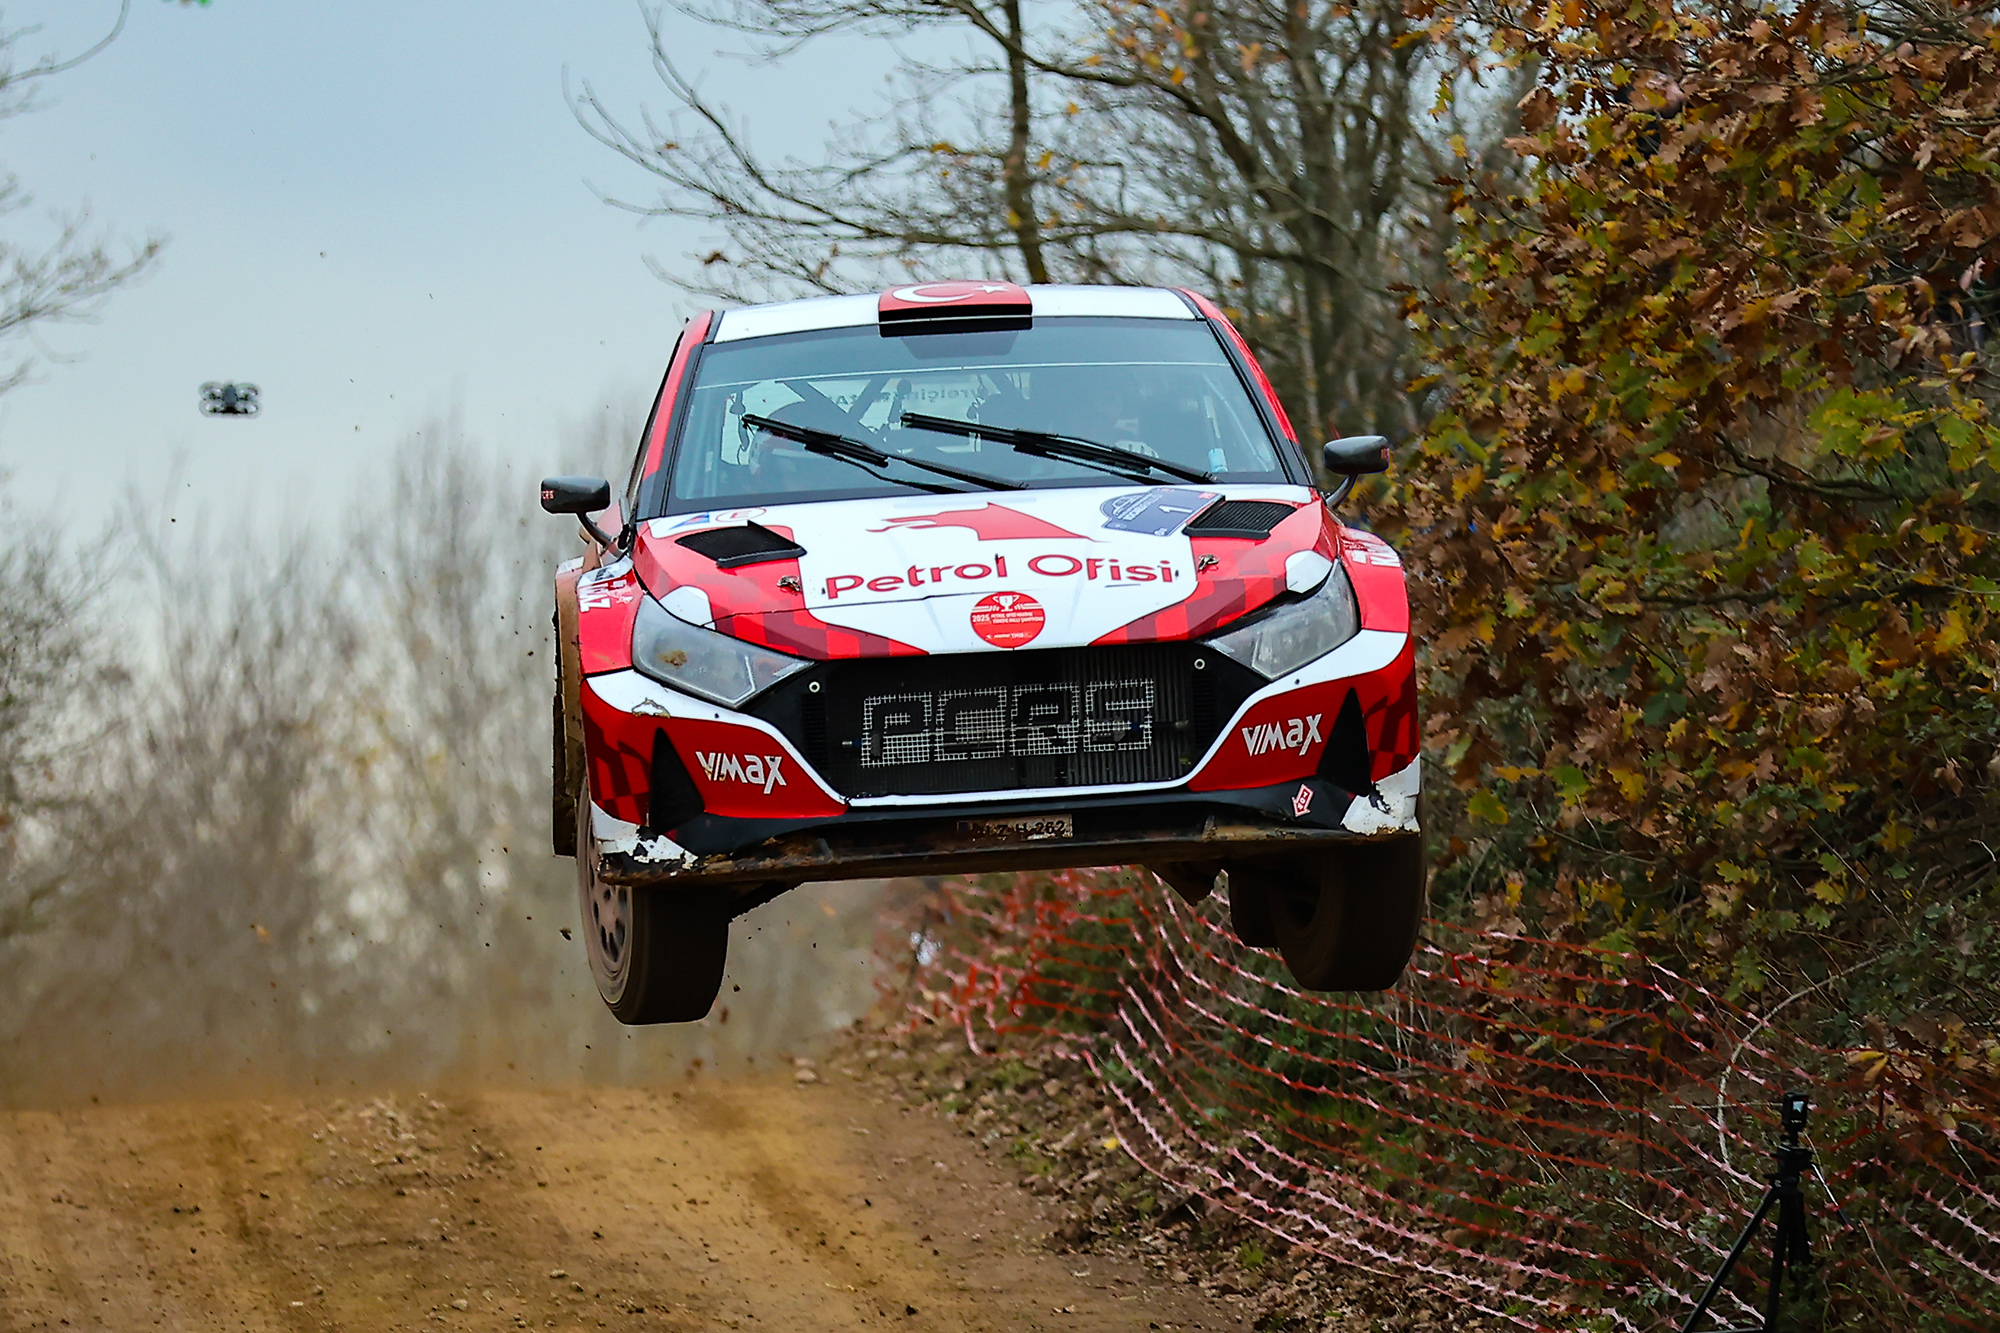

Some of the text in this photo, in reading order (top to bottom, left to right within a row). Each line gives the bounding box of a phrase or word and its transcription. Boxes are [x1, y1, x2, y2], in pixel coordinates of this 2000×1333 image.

[825, 553, 1174, 600] Petrol Ofisi
[972, 613, 990, 623] 2025
